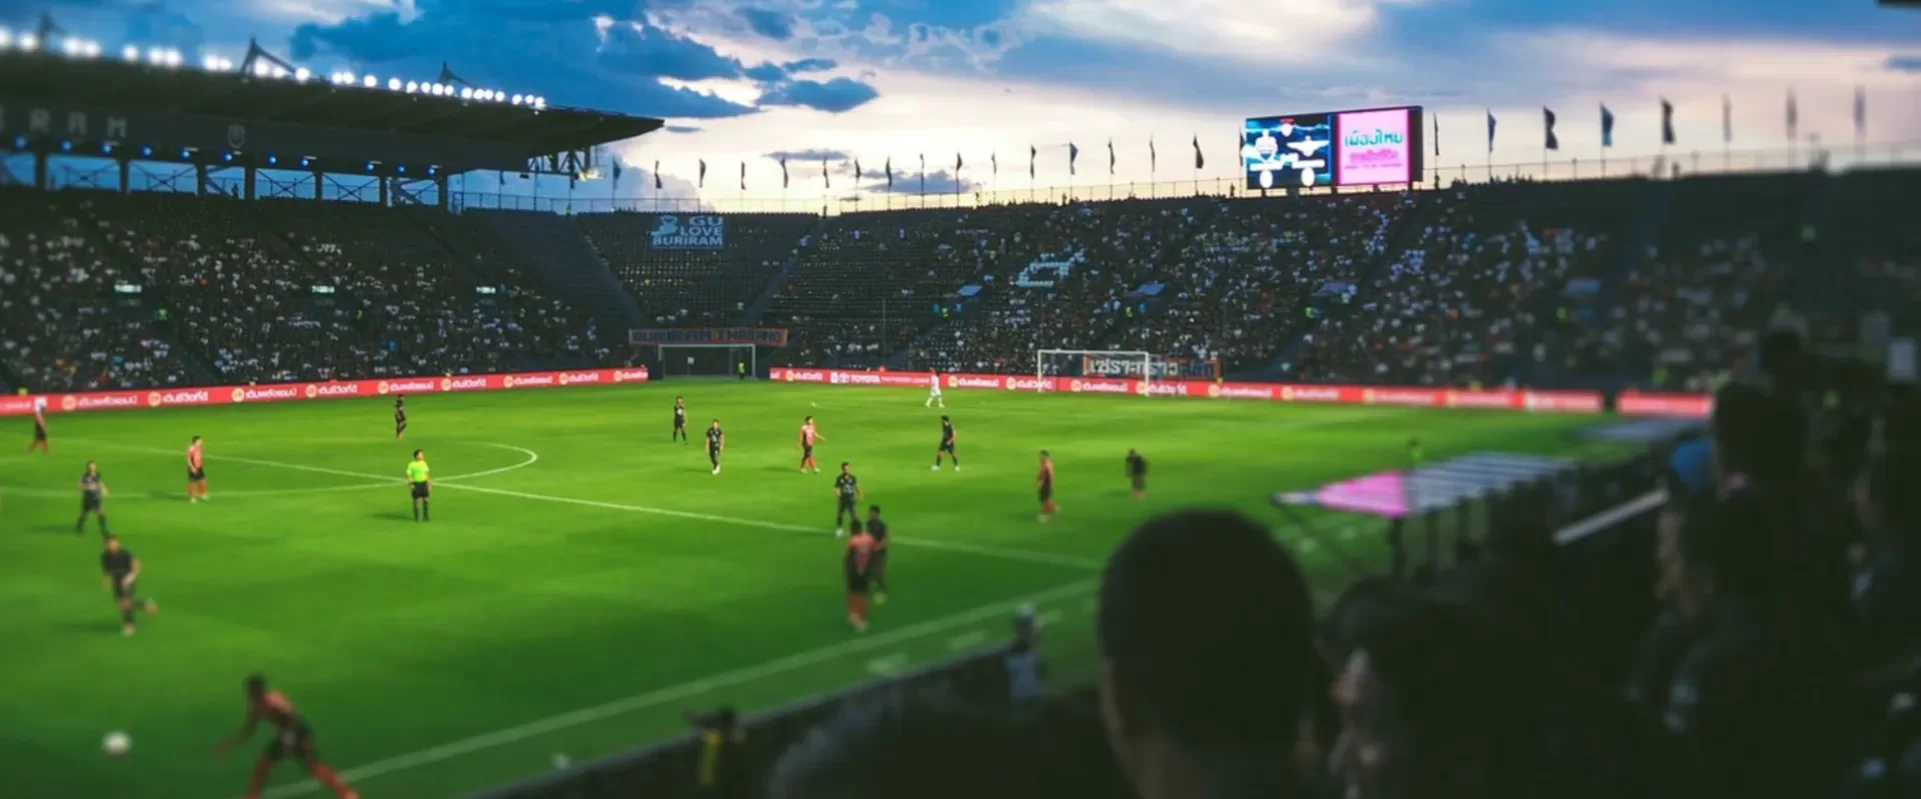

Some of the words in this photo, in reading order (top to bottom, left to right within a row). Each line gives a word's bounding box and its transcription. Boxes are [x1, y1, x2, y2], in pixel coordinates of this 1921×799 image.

[689, 216, 723, 226] GU
[680, 226, 723, 237] LOVE
[652, 235, 723, 245] BURIRAM
[851, 373, 881, 384] TOYOTA
